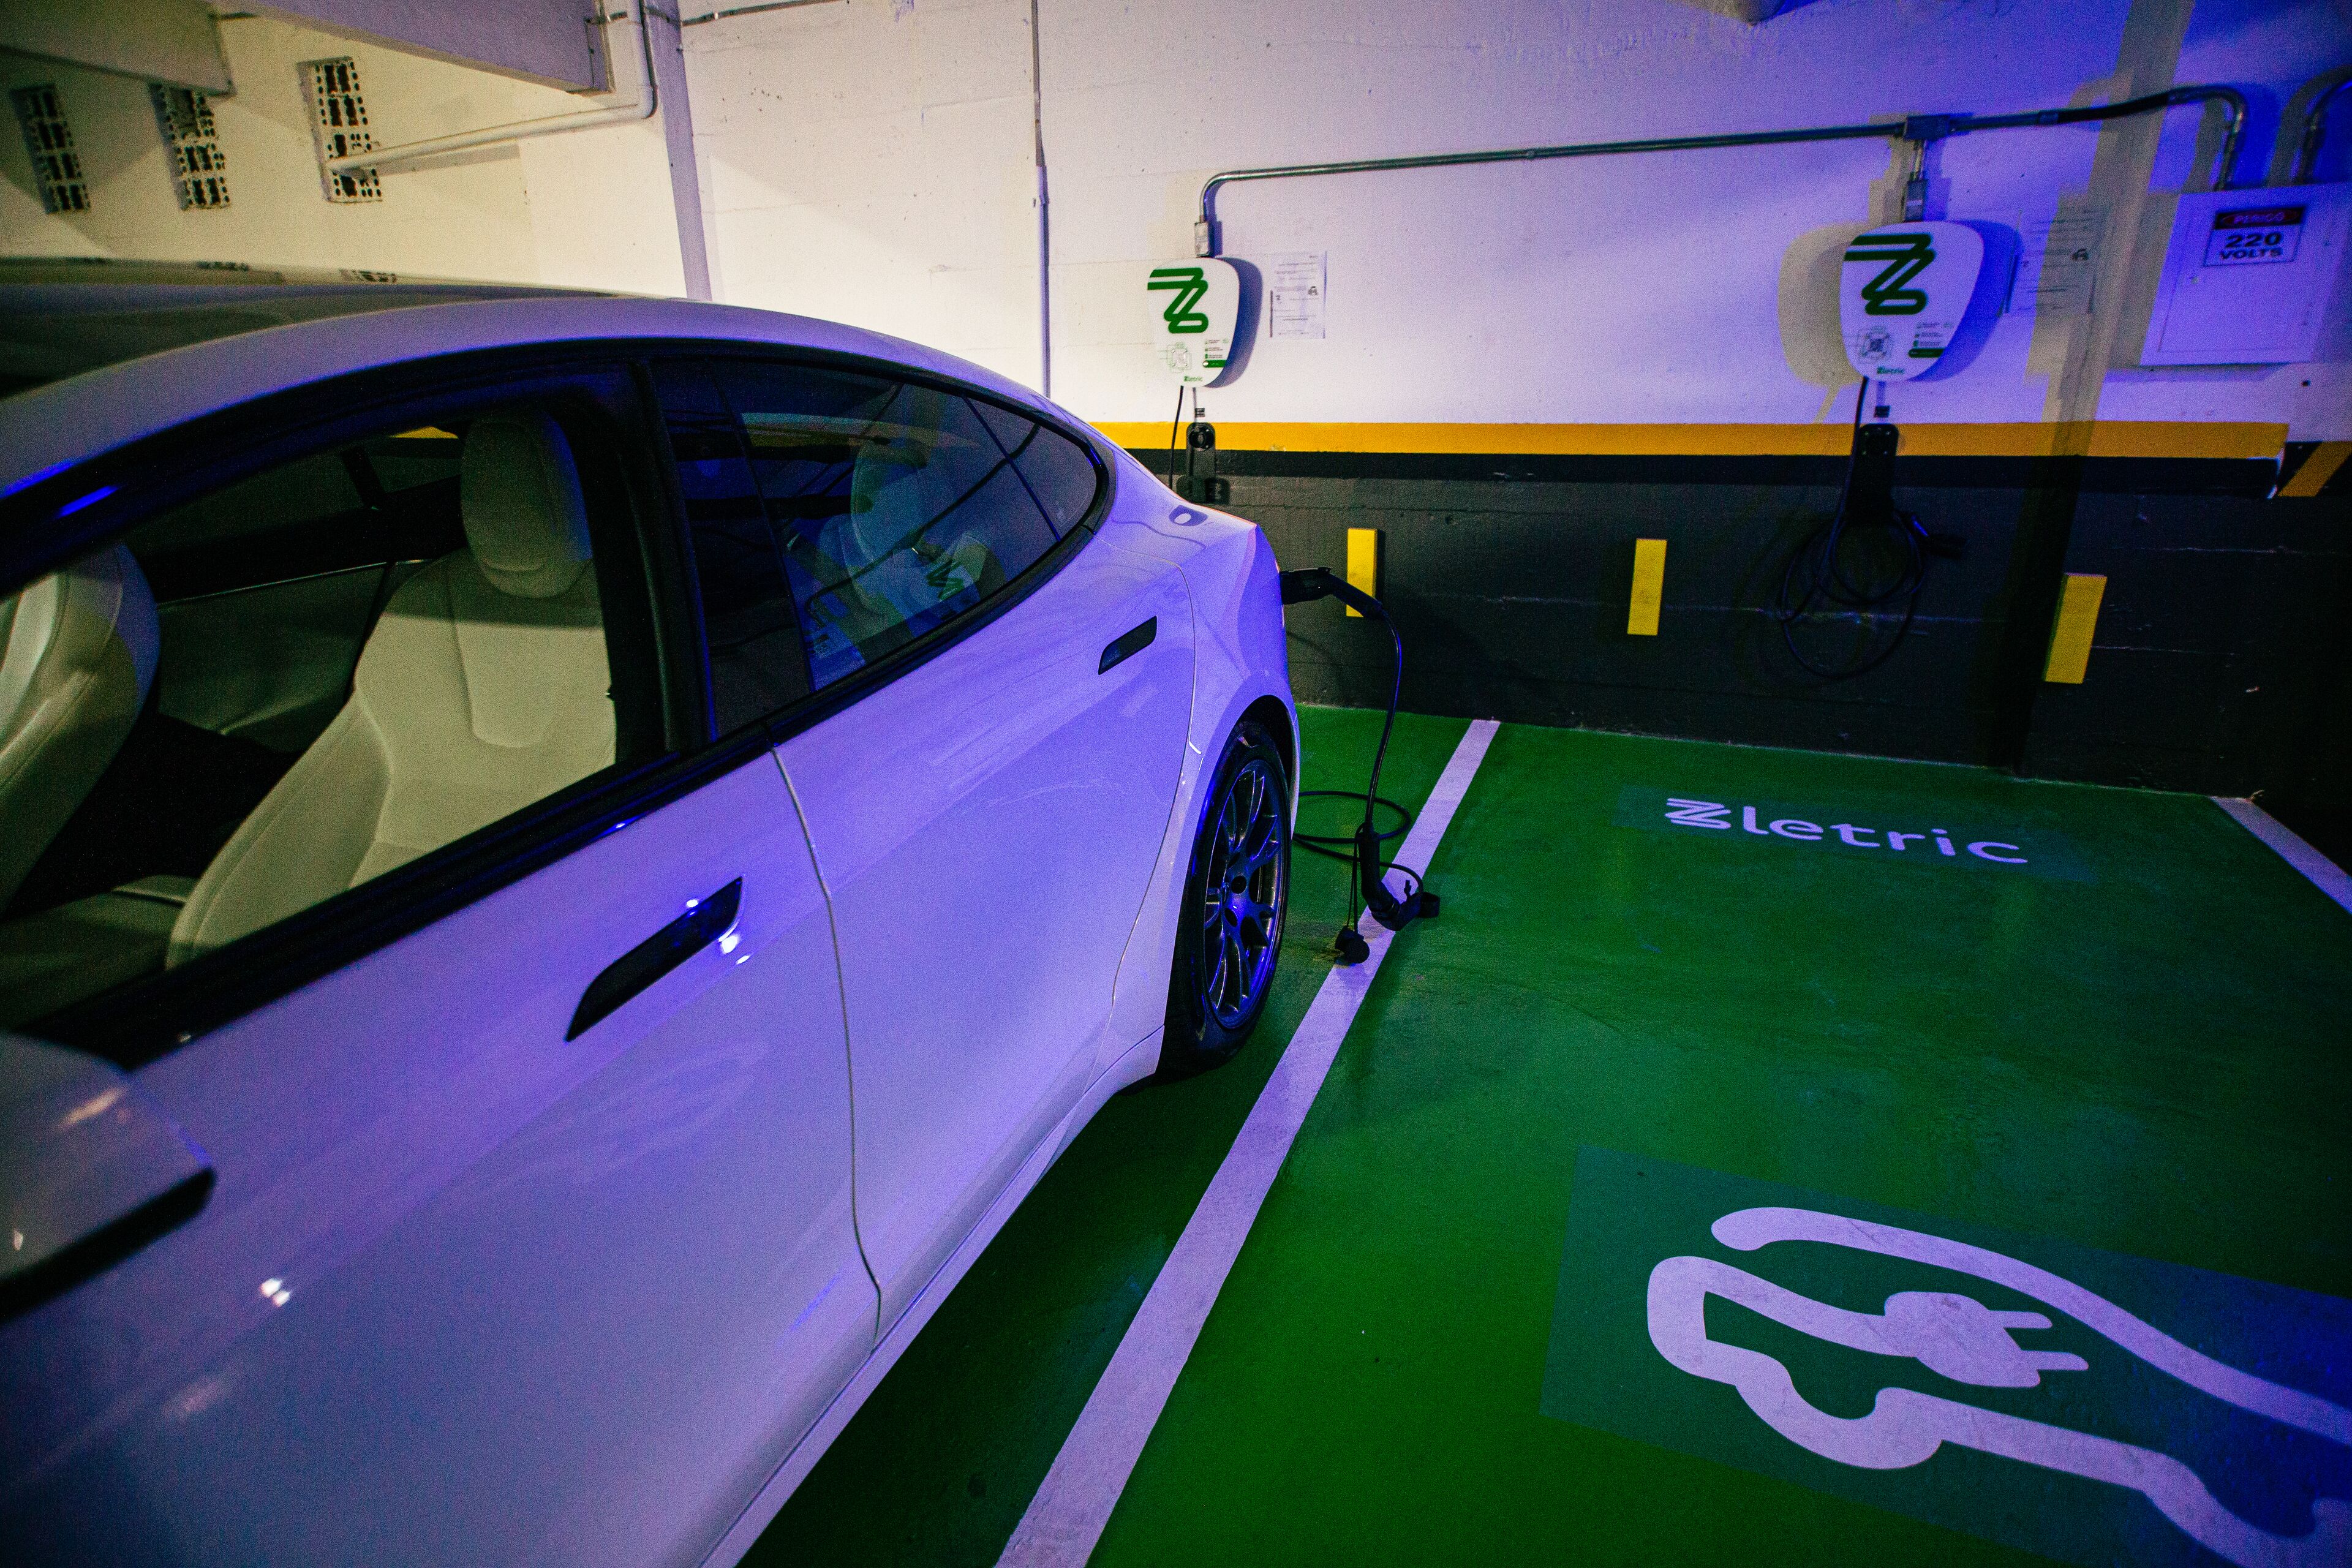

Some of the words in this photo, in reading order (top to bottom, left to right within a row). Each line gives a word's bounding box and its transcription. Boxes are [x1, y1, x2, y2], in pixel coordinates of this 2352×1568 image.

[2225, 232, 2282, 248] 220
[2220, 248, 2282, 260] VOLTS
[1665, 797, 2028, 865] Zletric
